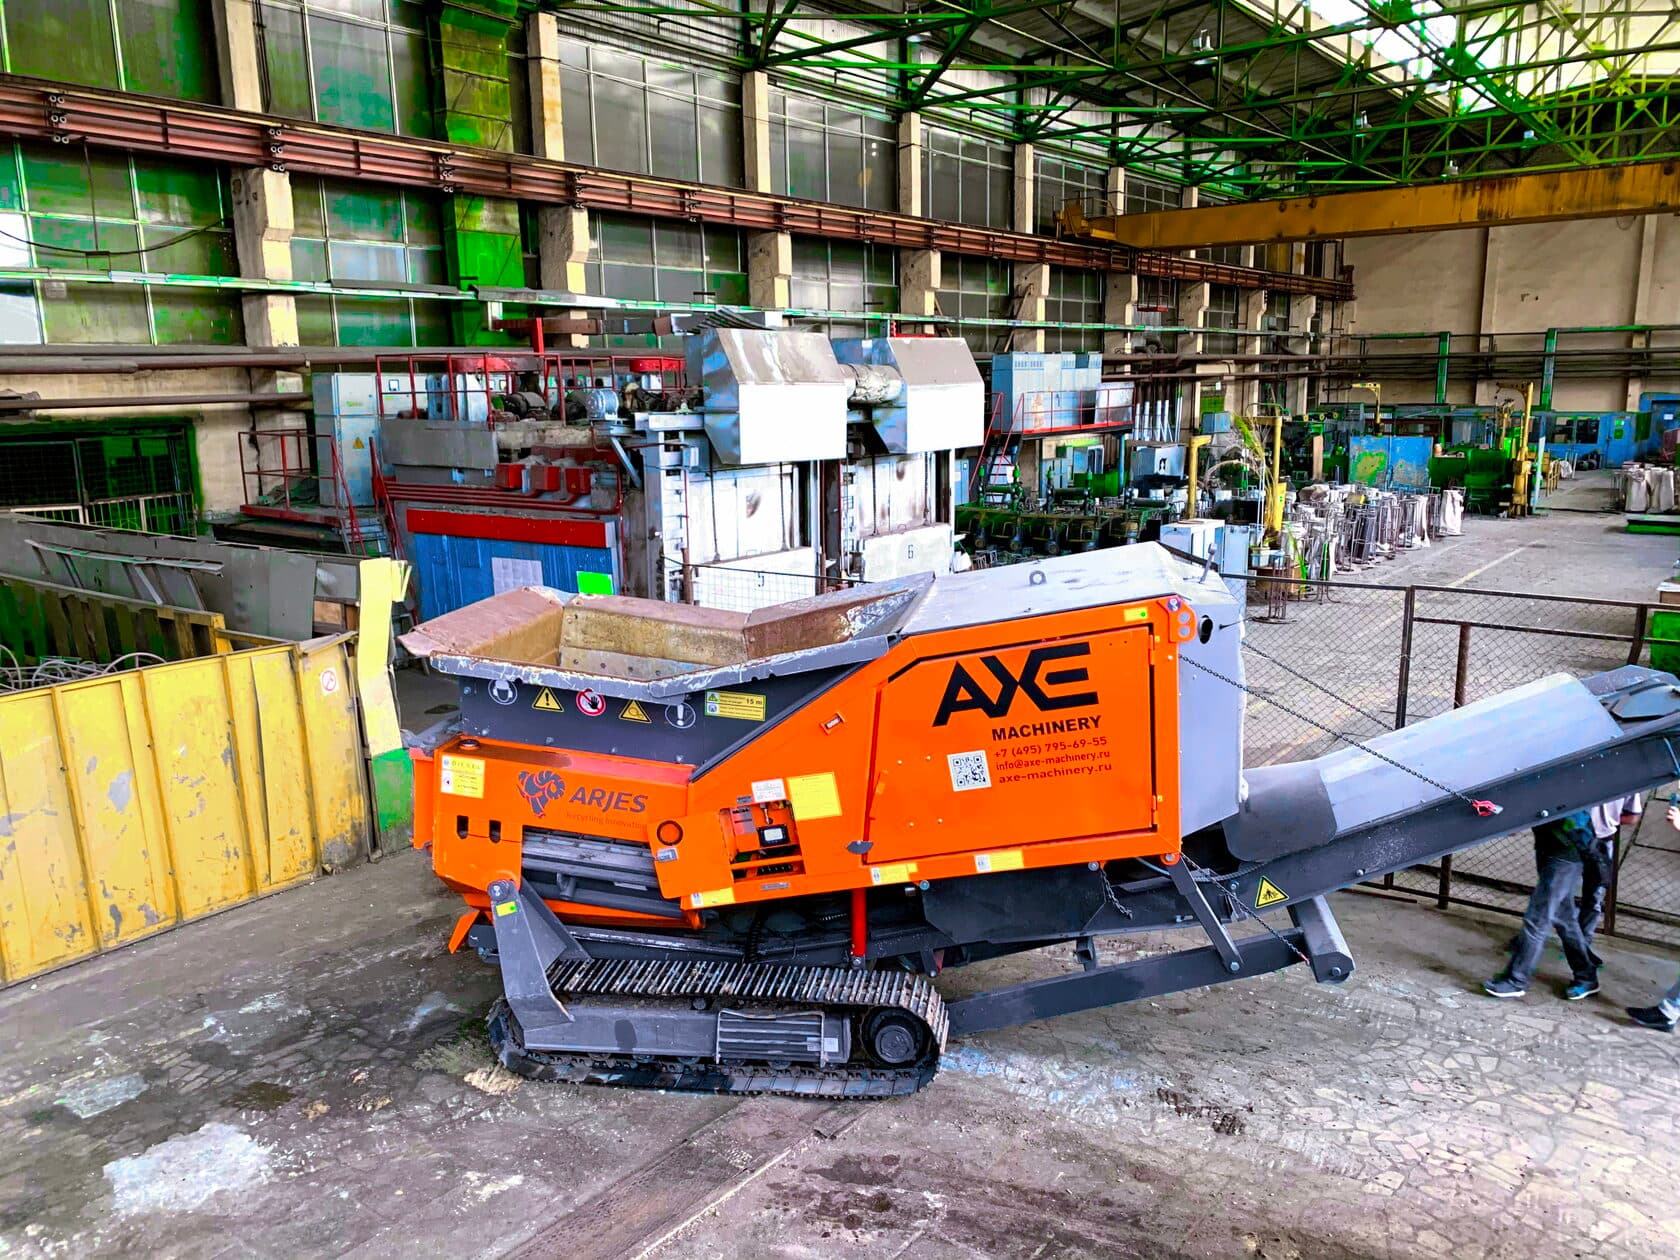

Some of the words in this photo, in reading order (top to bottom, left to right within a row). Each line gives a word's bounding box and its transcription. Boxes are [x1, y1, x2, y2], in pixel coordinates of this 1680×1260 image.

[907, 544, 914, 559] 6
[932, 642, 1099, 727] AXE
[991, 715, 1101, 741] MACHINERY
[994, 748, 1007, 758] +7
[1011, 744, 1042, 757] (495)
[1044, 736, 1107, 752] 795-69-55
[996, 751, 1110, 770] info@axe-machinery.ru
[999, 763, 1112, 783] axe-machinery.ru
[568, 786, 648, 813] ARJES
